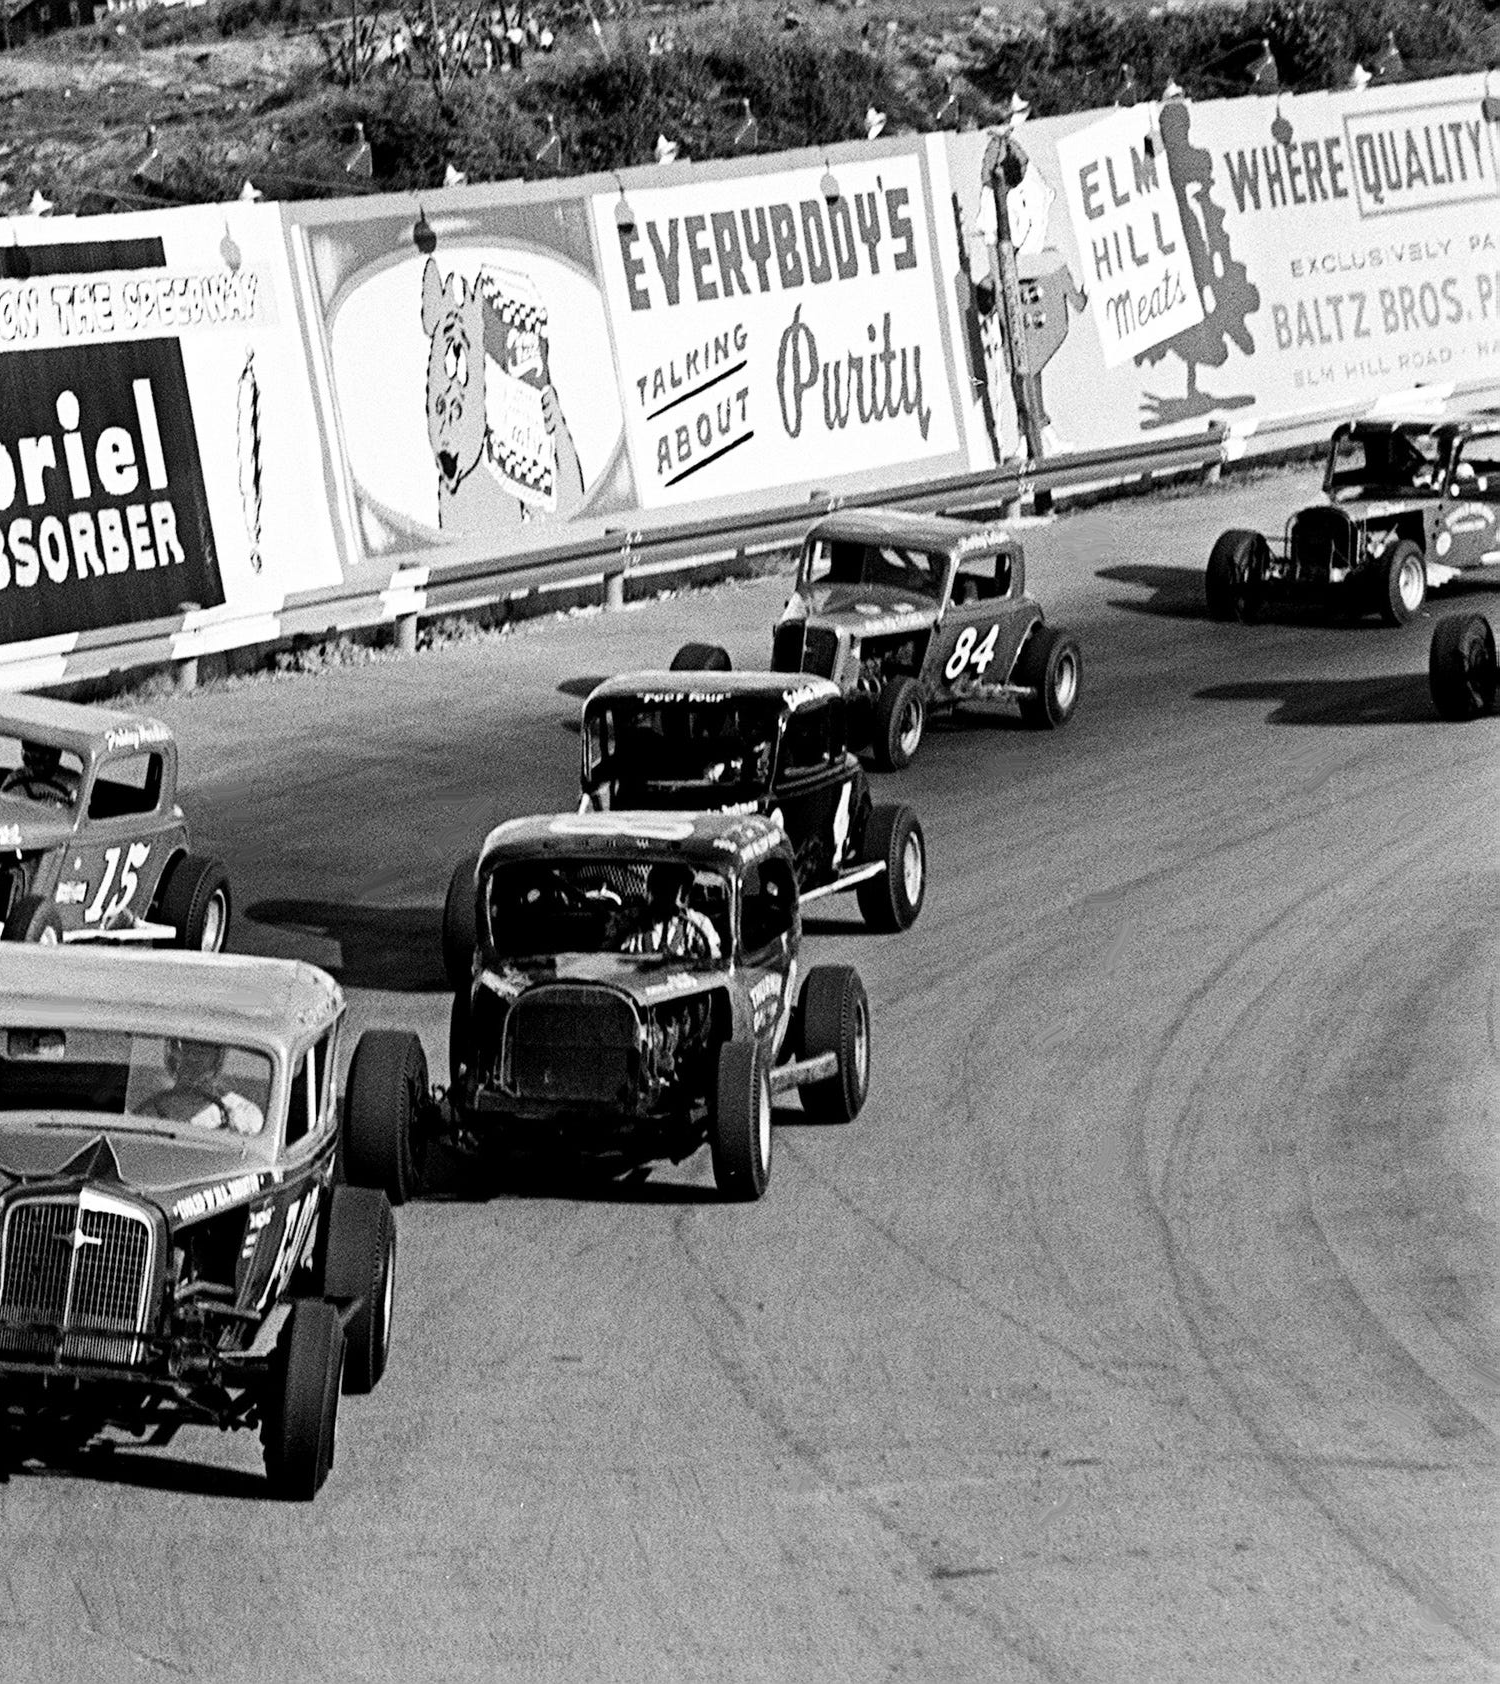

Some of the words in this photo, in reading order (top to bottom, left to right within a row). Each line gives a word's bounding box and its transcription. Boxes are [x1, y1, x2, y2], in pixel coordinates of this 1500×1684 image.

[1079, 146, 1160, 220] ELM
[1223, 136, 1349, 213] WHERE
[1356, 120, 1484, 204] QUALITY
[618, 175, 917, 311] EVERYBODY'S
[1092, 211, 1176, 281] HILL
[1291, 238, 1451, 278] EXCLUSIVELY
[51, 282, 114, 336] THE
[123, 272, 258, 330] SPEEDWAY
[1106, 269, 1186, 339] Meats
[1272, 291, 1371, 350] BALTZ
[637, 323, 748, 406] TALKING
[776, 302, 931, 441] Purity
[657, 386, 749, 475] ABOUT
[945, 624, 1000, 680] 84
[85, 842, 151, 930] 15
